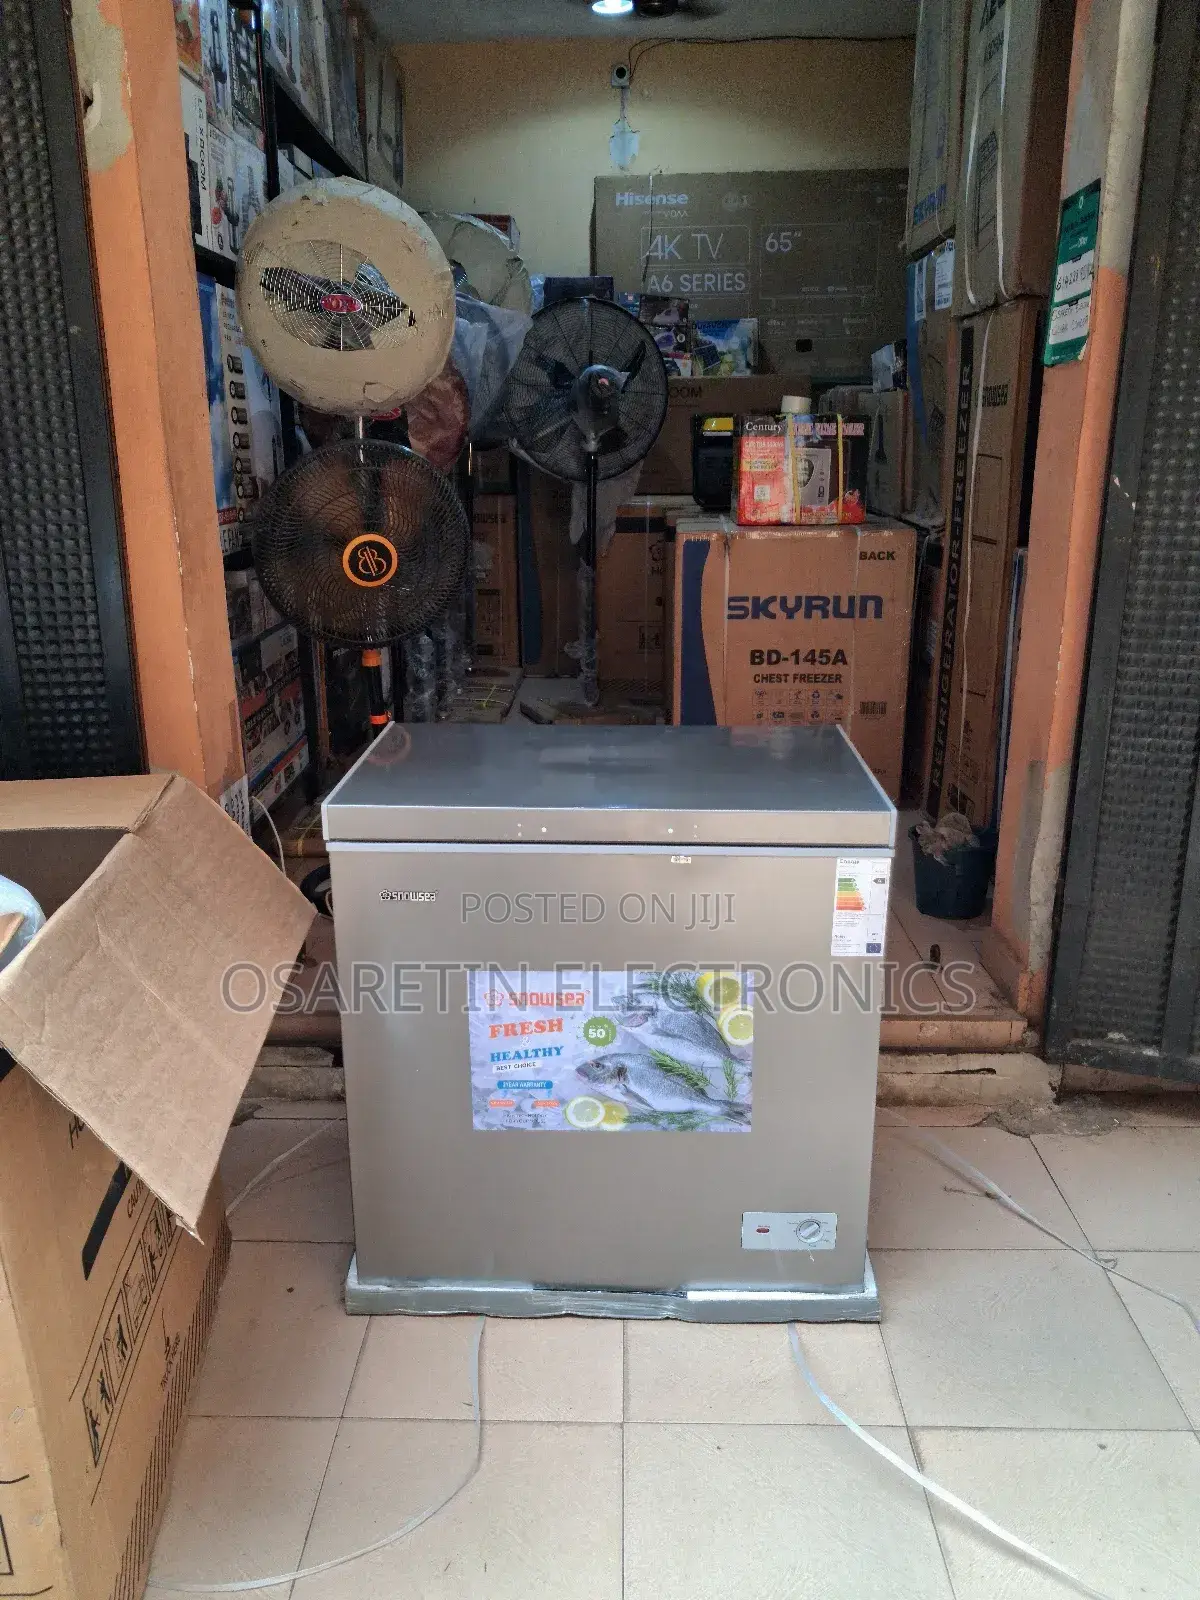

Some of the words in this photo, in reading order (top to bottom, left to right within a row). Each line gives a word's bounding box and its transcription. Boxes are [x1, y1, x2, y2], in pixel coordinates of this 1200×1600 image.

[615, 192, 690, 206] Hisense
[641, 234, 683, 260] 4K
[691, 232, 724, 259] TV
[647, 274, 674, 293] A6
[679, 272, 747, 292] SERIES
[745, 421, 784, 434] Century
[859, 551, 896, 561] BACK
[727, 595, 884, 620] SKYRUN
[750, 649, 848, 666] BD-145A
[753, 673, 790, 684] CHEST
[792, 673, 842, 684] FREEZER
[488, 1017, 564, 1039] FRESH
[588, 1028, 606, 1039] 50
[490, 1045, 565, 1063] HEALTHY
